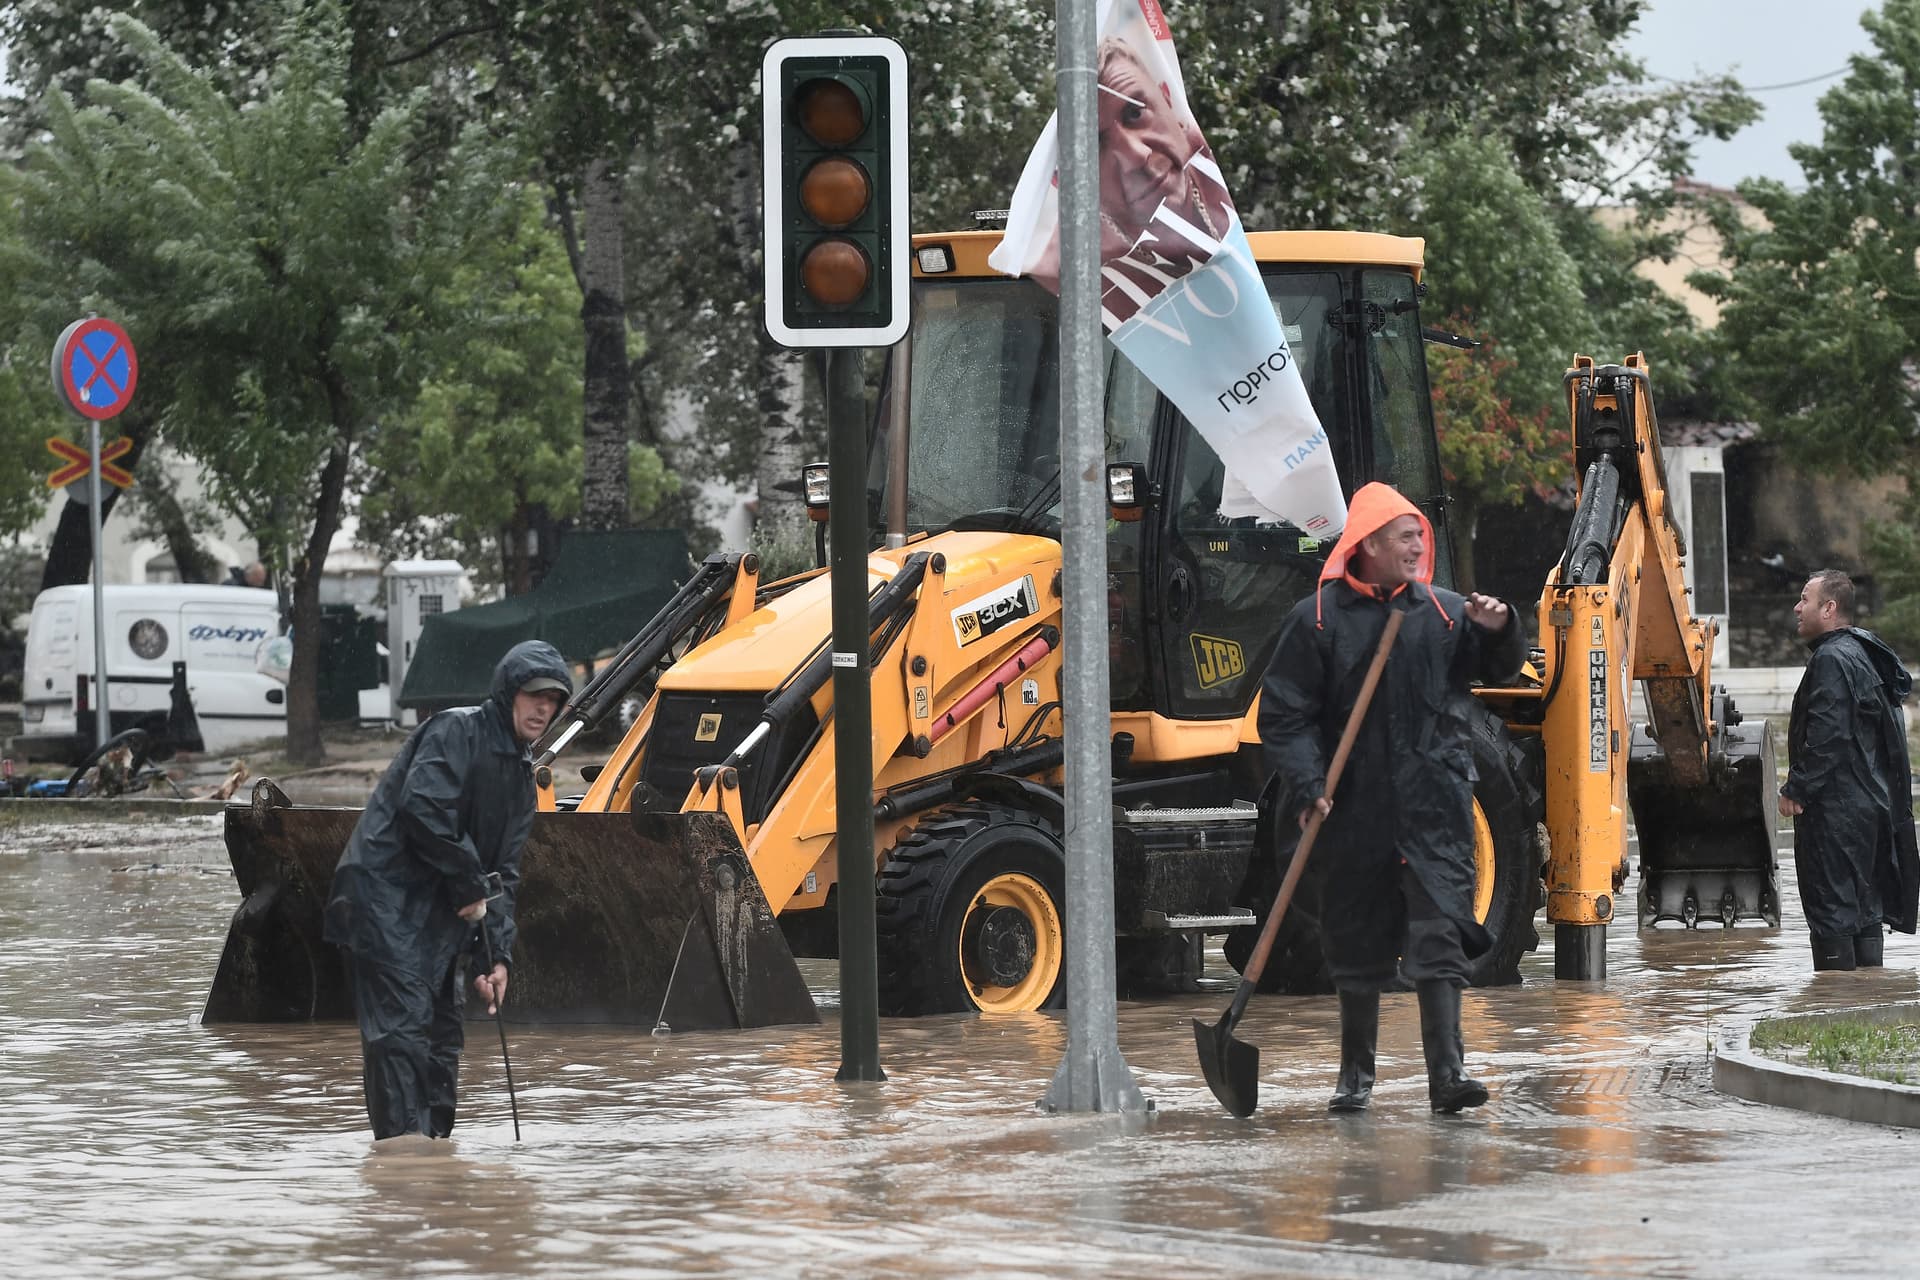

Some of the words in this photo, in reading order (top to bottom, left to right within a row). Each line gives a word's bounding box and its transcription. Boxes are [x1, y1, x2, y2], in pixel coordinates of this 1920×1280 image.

[1208, 540, 1230, 553] UNI
[960, 614, 977, 635] JCB
[980, 595, 1024, 625] 3CX
[1200, 639, 1242, 684] JCB
[1023, 690, 1034, 704] 103
[1590, 652, 1607, 762] UNITRACK
